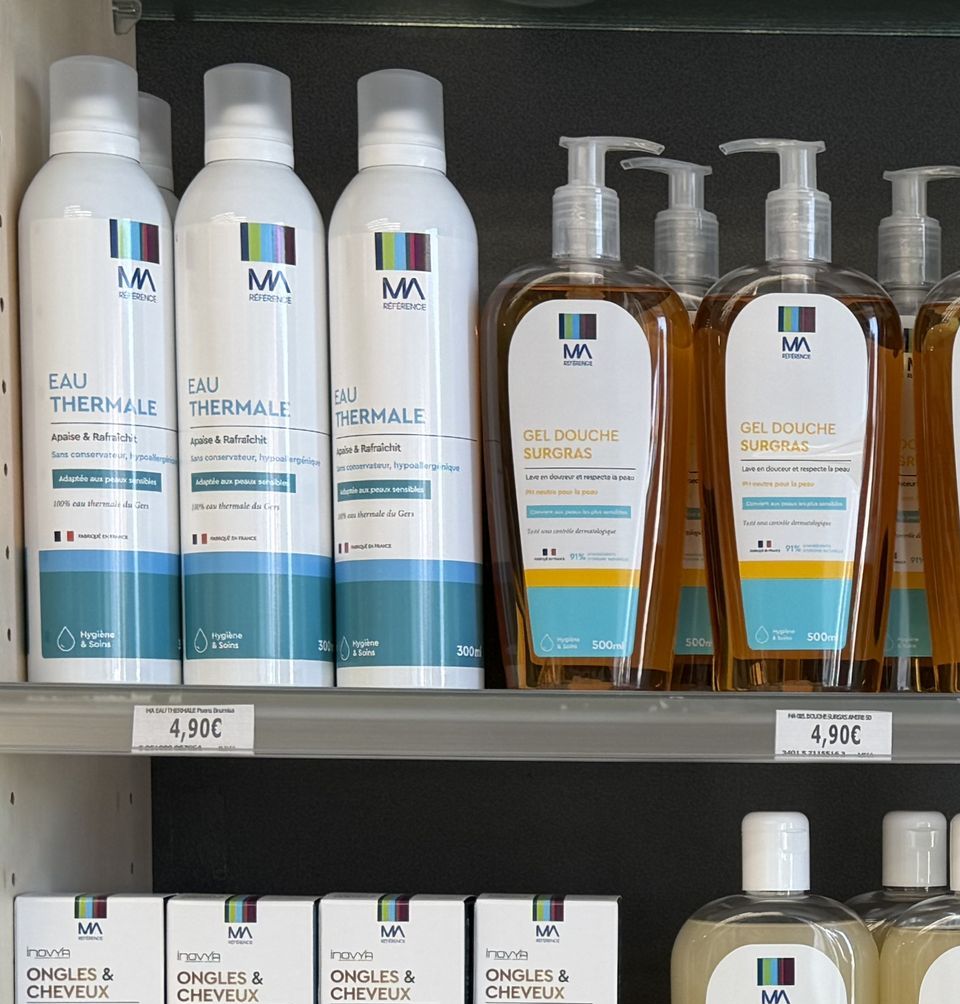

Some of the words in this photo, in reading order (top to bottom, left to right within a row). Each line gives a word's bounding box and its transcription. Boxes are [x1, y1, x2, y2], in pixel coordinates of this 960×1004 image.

[383, 277, 426, 301] MA
[49, 374, 87, 390] EAU
[188, 377, 219, 395] EAU
[50, 396, 158, 418] THERMALE
[190, 398, 291, 419] THERMALE
[335, 407, 426, 427] THERMALE
[523, 429, 551, 442] GEL
[554, 429, 619, 442] DOUCHE
[741, 422, 769, 435] GEL
[772, 422, 837, 435] DOUCHE
[191, 436, 213, 447] Apaise
[214, 436, 221, 446] &
[222, 434, 268, 446] Rafraîchit
[741, 439, 809, 452] SURGRAS
[524, 447, 593, 460] SURGRAS
[742, 465, 755, 473] Lave
[765, 465, 790, 473] douceur
[800, 466, 826, 475] respecte
[834, 467, 851, 475] peau
[592, 639, 625, 651] 500ml
[169, 718, 222, 743] 4,90€
[811, 724, 861, 748] 4,90€
[78, 922, 103, 935] MA
[27, 968, 97, 981] ONGLES
[102, 968, 114, 981] &
[177, 971, 247, 985] ONGLES
[252, 971, 263, 985] &
[330, 970, 400, 984] ONGLES
[404, 970, 415, 984] &
[27, 985, 109, 999] CHEVEUX
[177, 988, 259, 1003] CHEVEUX
[330, 987, 411, 1001] CHEVEUX
[762, 990, 791, 1004] MA
